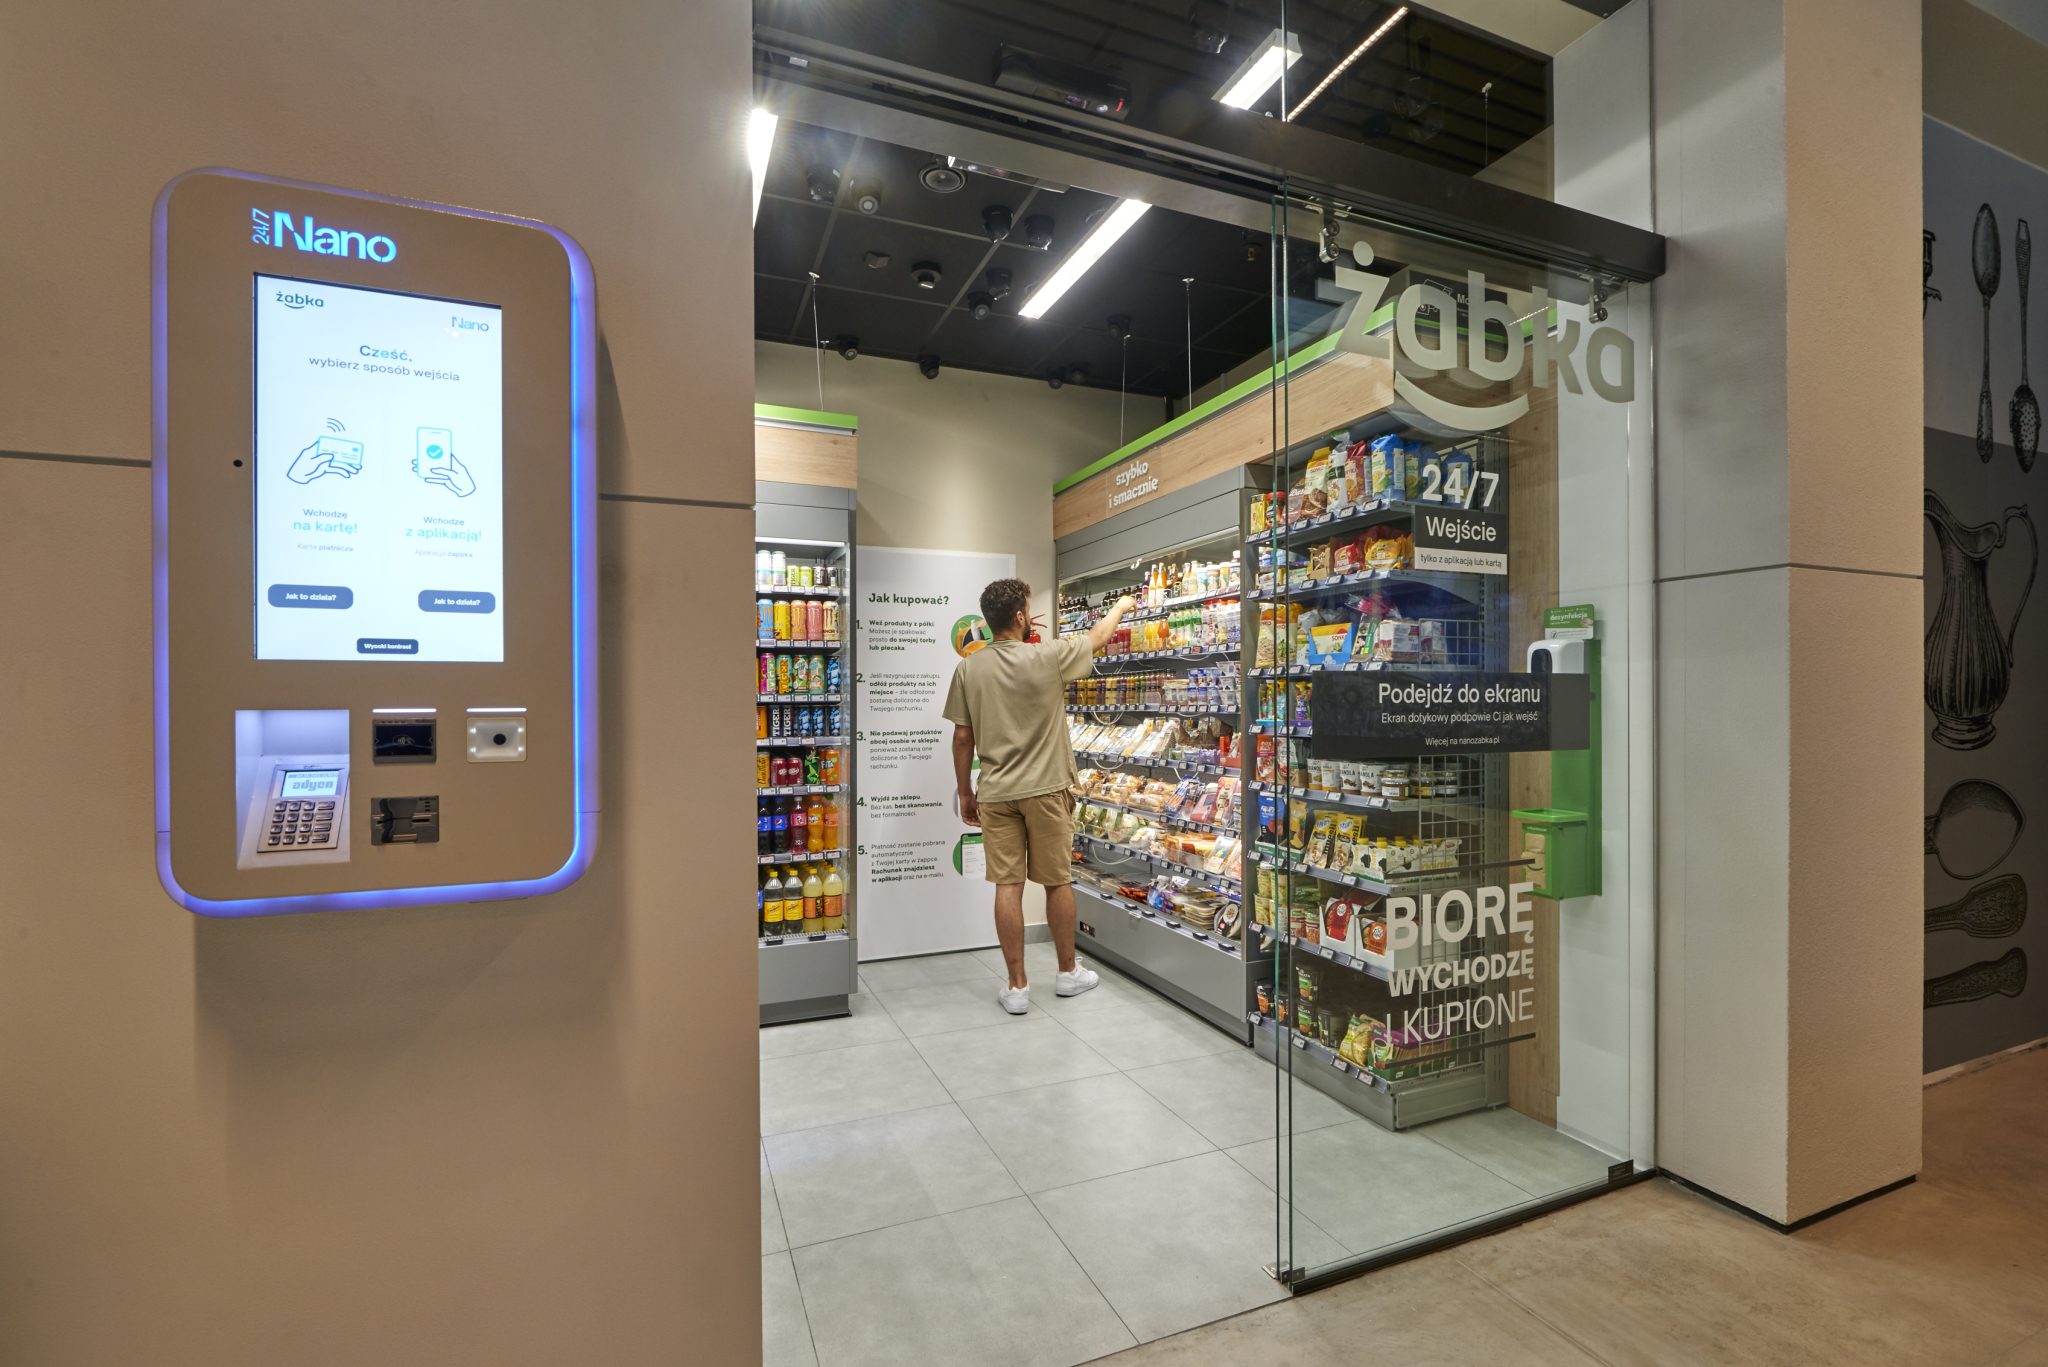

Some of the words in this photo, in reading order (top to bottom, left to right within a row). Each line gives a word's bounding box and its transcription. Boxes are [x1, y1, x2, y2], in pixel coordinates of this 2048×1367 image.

[252, 208, 270, 245] 24/7
[273, 211, 397, 264] Nano
[275, 291, 324, 309] żabka
[451, 316, 489, 332] Nano
[1335, 240, 1635, 404] żabka
[309, 357, 360, 371] wybierz
[363, 362, 410, 377] sposób
[413, 368, 460, 382] wejścia
[1116, 460, 1149, 487] szybko
[1108, 494, 1113, 509] i
[1114, 476, 1158, 506] smacznie
[1422, 464, 1500, 510] 24/7
[293, 521, 311, 532] na
[316, 520, 358, 534] kartę!
[406, 528, 414, 537] z
[418, 527, 482, 542] aplikacją!
[1426, 516, 1496, 544] Wejście
[1420, 554, 1438, 564] tylko
[1444, 556, 1472, 566] aplikacją
[868, 592, 890, 604] Jak
[893, 594, 949, 606] kupować?
[856, 673, 866, 683] 2.
[1378, 683, 1452, 708] Podejdź
[1458, 683, 1480, 704] do
[1484, 683, 1540, 704] ekranu
[1382, 712, 1406, 724] Ekran
[1408, 712, 1449, 724] dotykowy
[1450, 712, 1490, 724] podpowie
[1492, 711, 1500, 720] Ci
[1502, 712, 1514, 723] jak
[1516, 711, 1538, 722] wejść
[857, 732, 866, 741] 3.
[1425, 737, 1449, 747] Więcej
[292, 780, 334, 792] adyen
[857, 797, 867, 806] 4.
[858, 846, 868, 855] 5.
[878, 875, 902, 883] aplikacji
[1388, 948, 1534, 998] WYCHODZĘ
[1386, 1013, 1392, 1044] I
[1404, 988, 1534, 1044] KUPIONE
